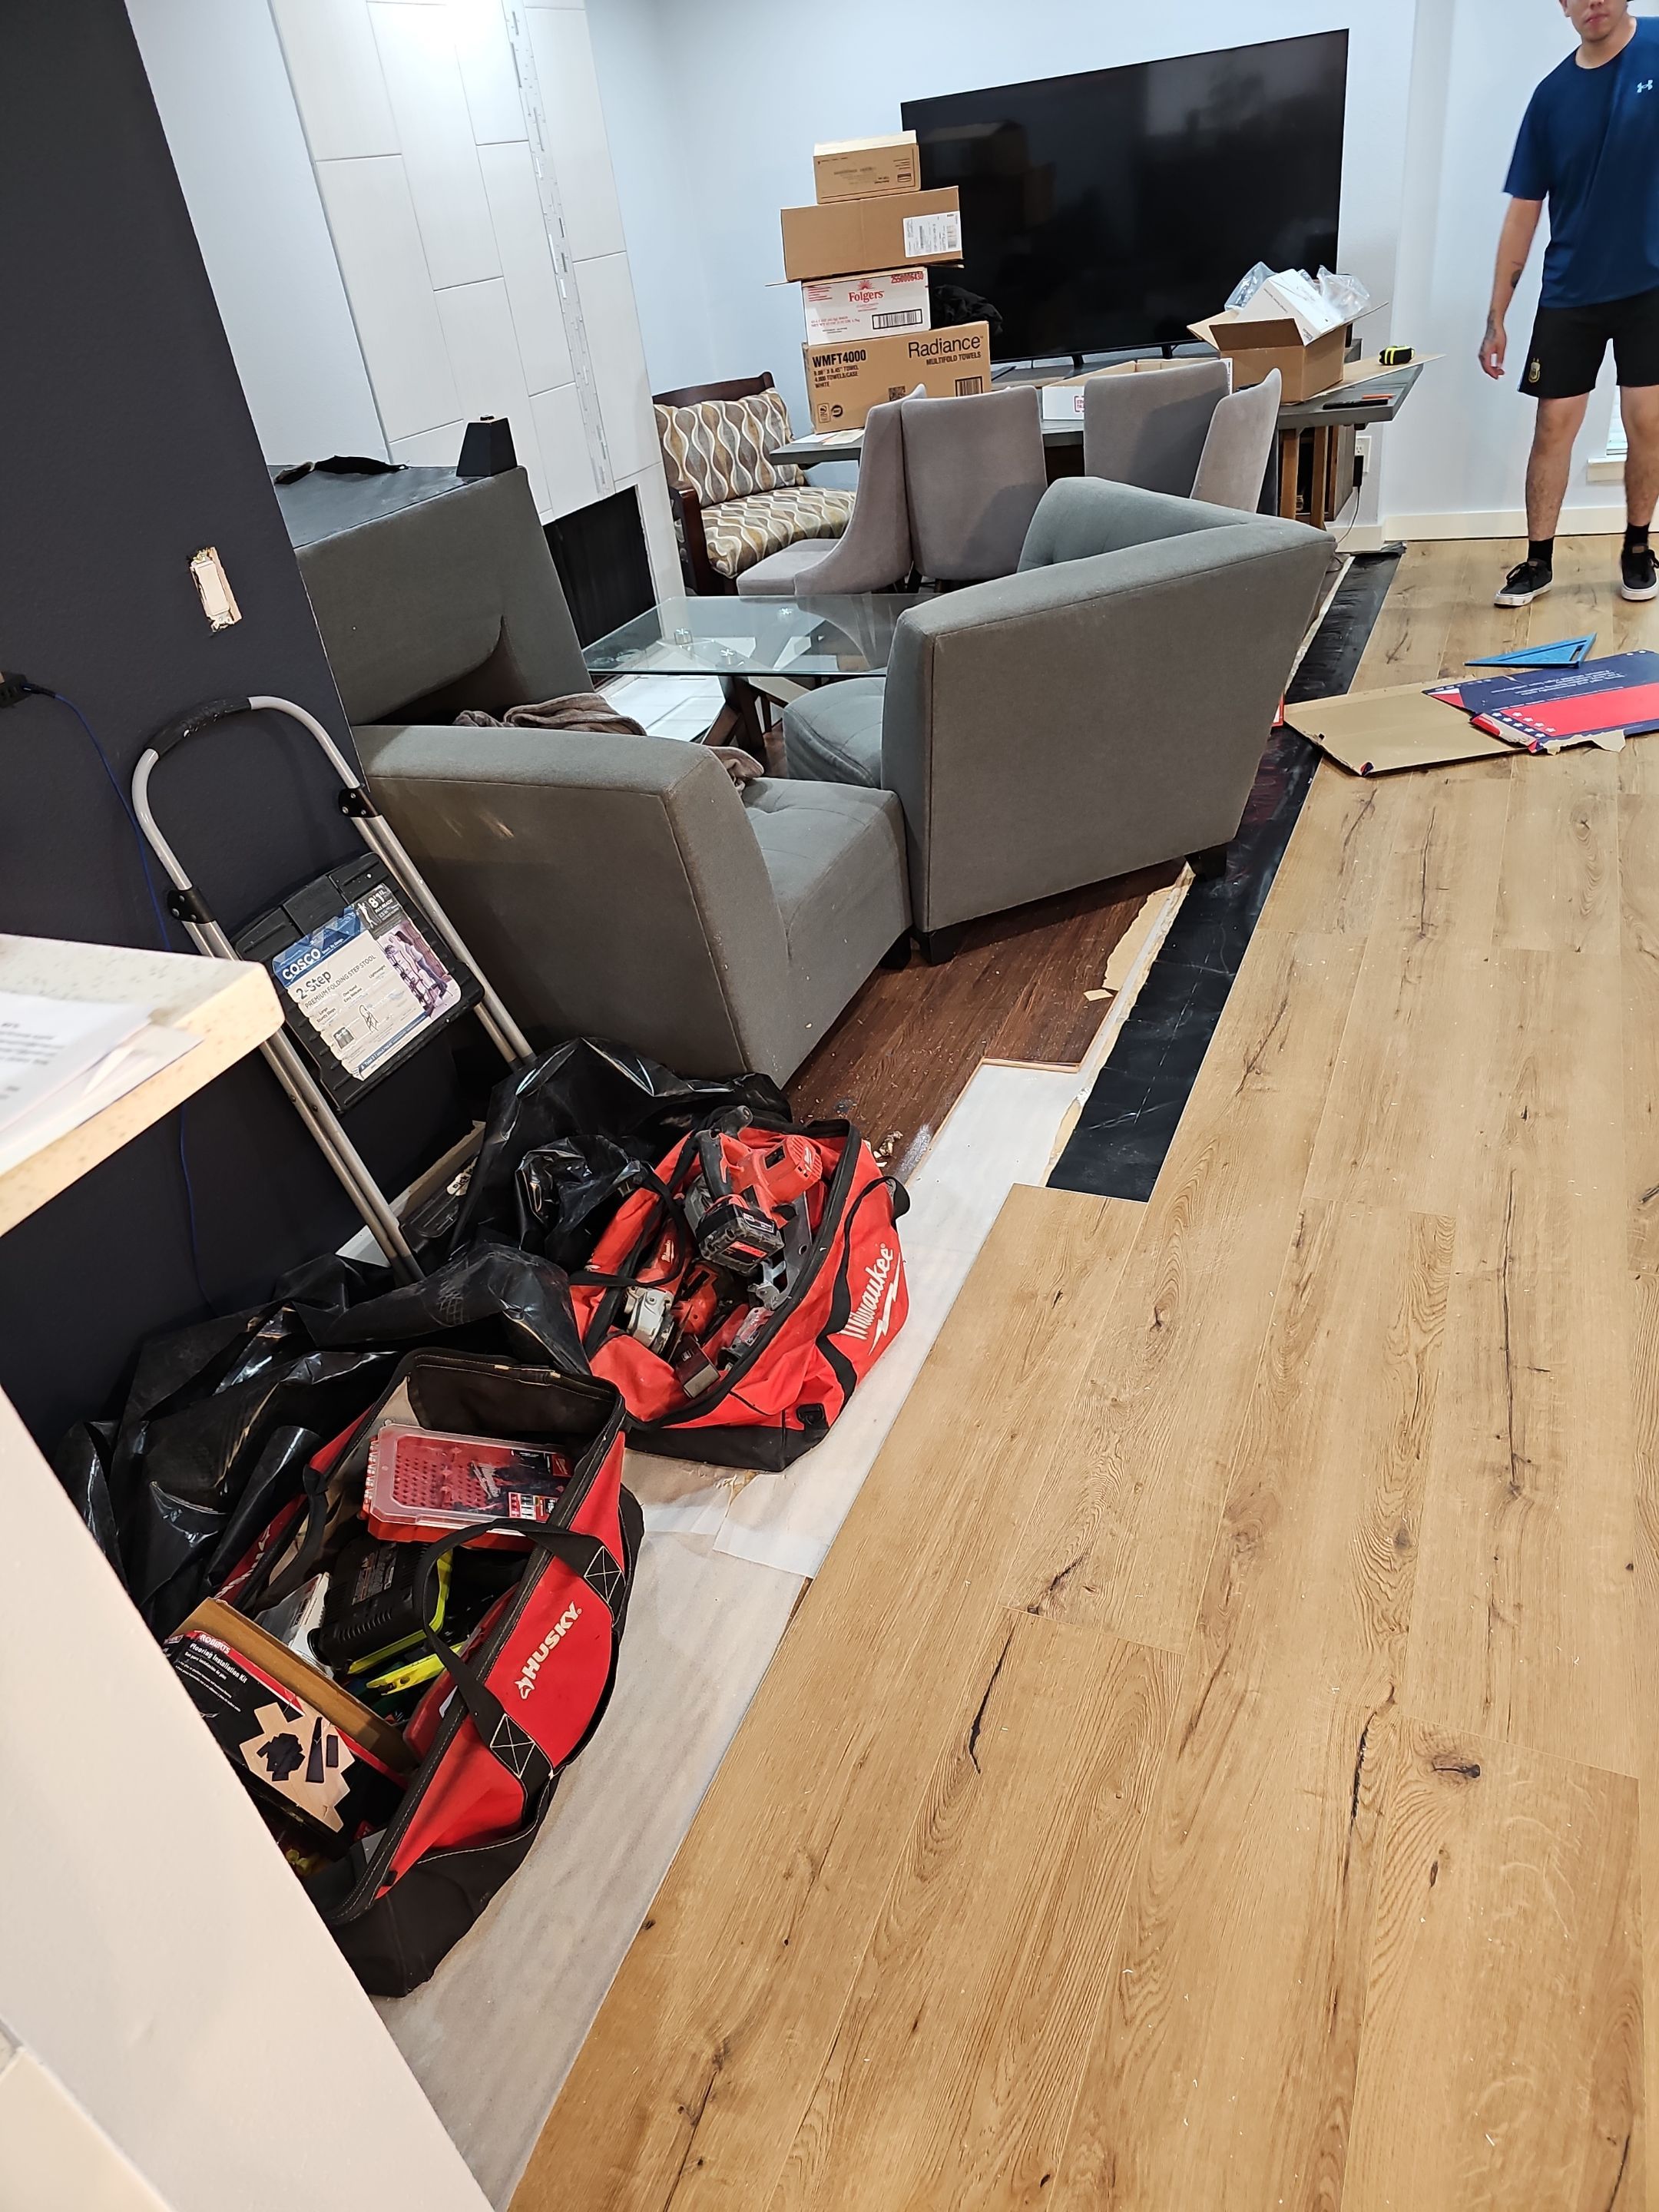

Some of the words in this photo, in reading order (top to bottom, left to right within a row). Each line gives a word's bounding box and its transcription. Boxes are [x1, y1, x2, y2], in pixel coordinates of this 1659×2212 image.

[849, 290, 884, 303] Folgers
[813, 349, 866, 368] WMFT4000
[908, 336, 981, 359] Radiance
[926, 354, 958, 366] MULTIFOLD
[959, 351, 982, 360] TOWELS
[282, 948, 321, 980] COSCO
[296, 971, 331, 999] 2-Step
[305, 988, 329, 1009] PREMIUM
[327, 973, 349, 993] FOLDING
[347, 965, 359, 977] STEP
[359, 954, 376, 969] STOOL
[839, 1247, 893, 1339] Milwaukee
[199, 1634, 230, 1654] ROBERTS
[522, 1601, 579, 1680] HUSKY
[189, 1643, 214, 1659] Flooring
[212, 1654, 240, 1677] Installation
[238, 1674, 247, 1684] Kit
